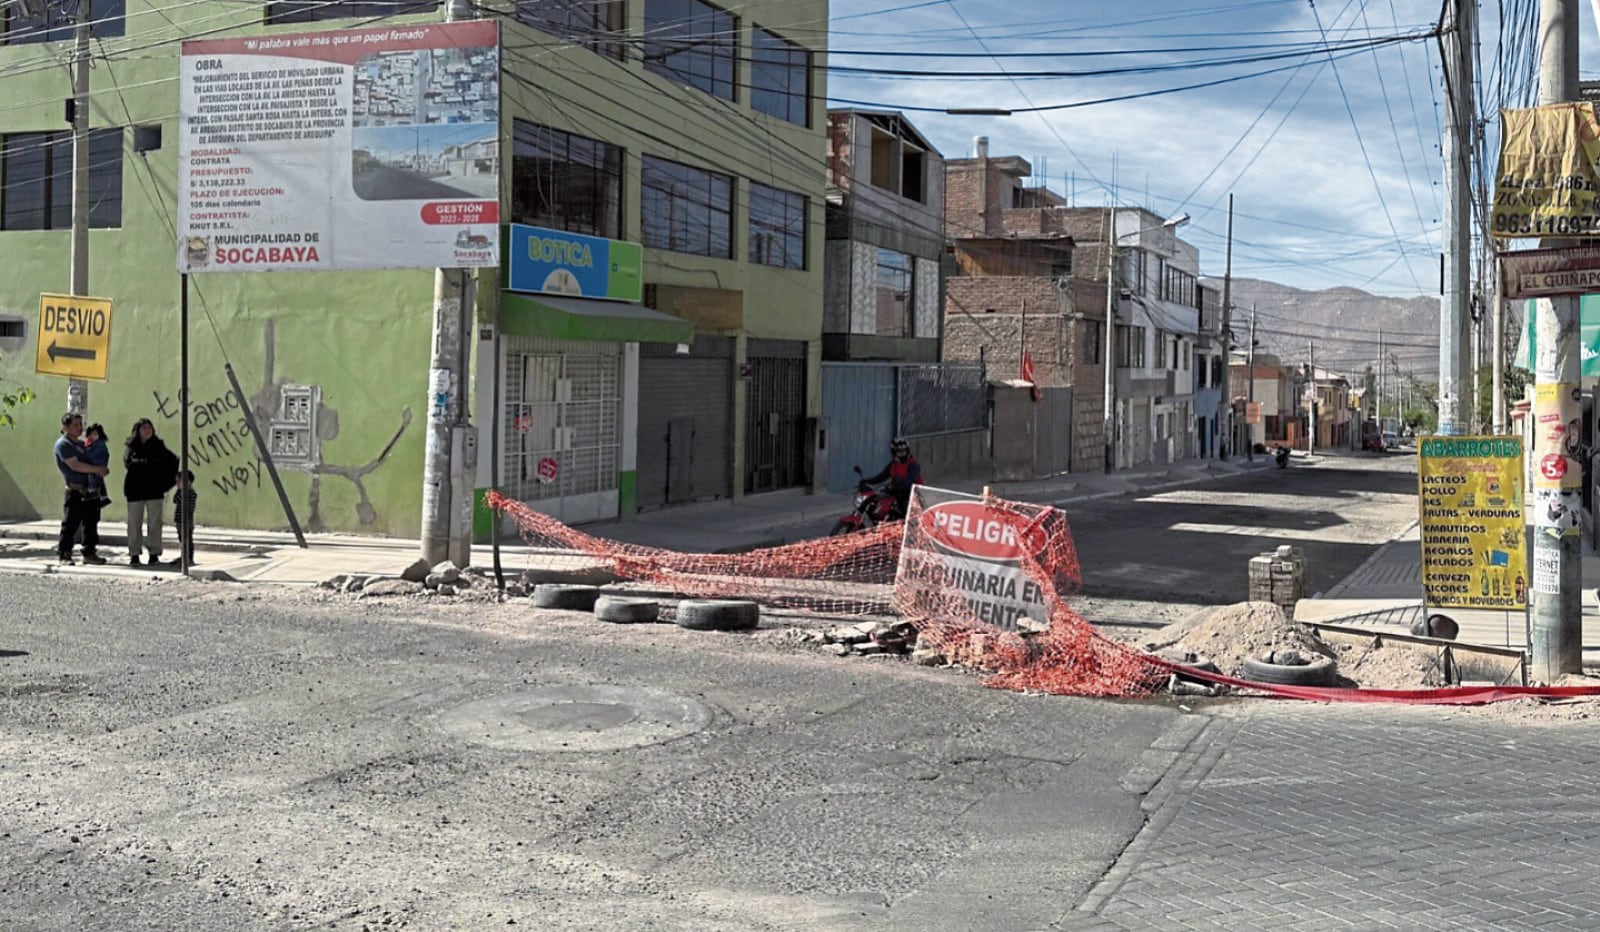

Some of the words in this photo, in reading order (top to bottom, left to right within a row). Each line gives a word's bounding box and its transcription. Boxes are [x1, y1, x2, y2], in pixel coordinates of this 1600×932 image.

[259, 39, 291, 51] palabra
[293, 37, 310, 47] vale
[312, 36, 330, 46] más
[333, 35, 349, 47] que
[351, 34, 362, 43] un
[363, 31, 389, 45] papel
[390, 28, 430, 41] firmado"
[195, 59, 223, 71] OBRA
[238, 71, 250, 81] DEL
[251, 69, 278, 80] SERVICIO
[279, 69, 287, 78] DE
[287, 68, 319, 78] MOVILIDAD
[320, 66, 344, 76] URBANA
[193, 85, 202, 94] EN
[202, 84, 213, 93] LAS
[228, 81, 253, 91] LOCALES
[254, 81, 262, 90] DE
[263, 80, 271, 89] LA
[281, 79, 293, 88] LAS
[314, 77, 334, 86] DESDE
[334, 76, 342, 86] LA
[240, 92, 253, 102] CON
[253, 91, 261, 101] LA
[272, 90, 280, 99] LA
[307, 88, 327, 97] HASTA
[327, 87, 336, 97] LA
[238, 101, 251, 111] CON
[251, 101, 260, 110] LA
[303, 99, 309, 108] Y
[309, 98, 329, 108] DESDE
[329, 98, 338, 107] LA
[210, 114, 222, 123] CON
[223, 112, 245, 122] PASAJE
[246, 111, 265, 121] SANTA
[265, 110, 280, 120] ROSA
[281, 109, 301, 119] HASTA
[301, 109, 310, 118] LA
[334, 107, 348, 117] CON
[199, 123, 227, 134] AREQUIPA
[254, 121, 263, 131] DE
[263, 120, 294, 131] SOCABAYA
[294, 119, 303, 129] DE
[303, 119, 312, 128] LA
[198, 135, 207, 144] DE
[236, 133, 247, 142] DEL
[294, 130, 302, 139] DE
[190, 148, 241, 158] MODALIDAD:
[190, 157, 231, 166] CONTRATA
[190, 167, 254, 177] PRESUPUESTO:
[190, 190, 218, 199] PLAZO
[219, 189, 231, 198] DE
[232, 187, 285, 197] EJECUCIÓN:
[222, 199, 262, 208] calendario
[436, 203, 483, 214] GESTIÓN
[189, 211, 250, 220] CONTRATISTA:
[189, 222, 210, 231] KHUT
[213, 232, 302, 245] MUNICIPALIDAD
[304, 231, 320, 243] DE
[214, 246, 320, 265] SOCABAYA
[528, 235, 595, 268] BOTICA
[1524, 275, 1540, 289] EL
[44, 305, 105, 337] DESVIO
[1420, 438, 1521, 458] ABARROTES
[1422, 476, 1467, 484] LACTEOS
[1422, 487, 1457, 495] POLLO
[1423, 498, 1442, 506] RES
[1423, 509, 1459, 518] FRUTAS
[1468, 509, 1521, 518] VERDURAS
[934, 511, 1034, 546] PELIGR
[1423, 525, 1486, 534] EMBUTIDOS
[1424, 536, 1470, 545] LIBRERIA
[1424, 547, 1474, 556] REGALOS
[1425, 558, 1474, 567] HELADOS
[1425, 573, 1471, 582] CERVEZA
[1022, 580, 1045, 606] EN
[1425, 584, 1469, 593] LICORES
[1462, 595, 1468, 604] Y
[1469, 596, 1514, 606] NOVEDADES
